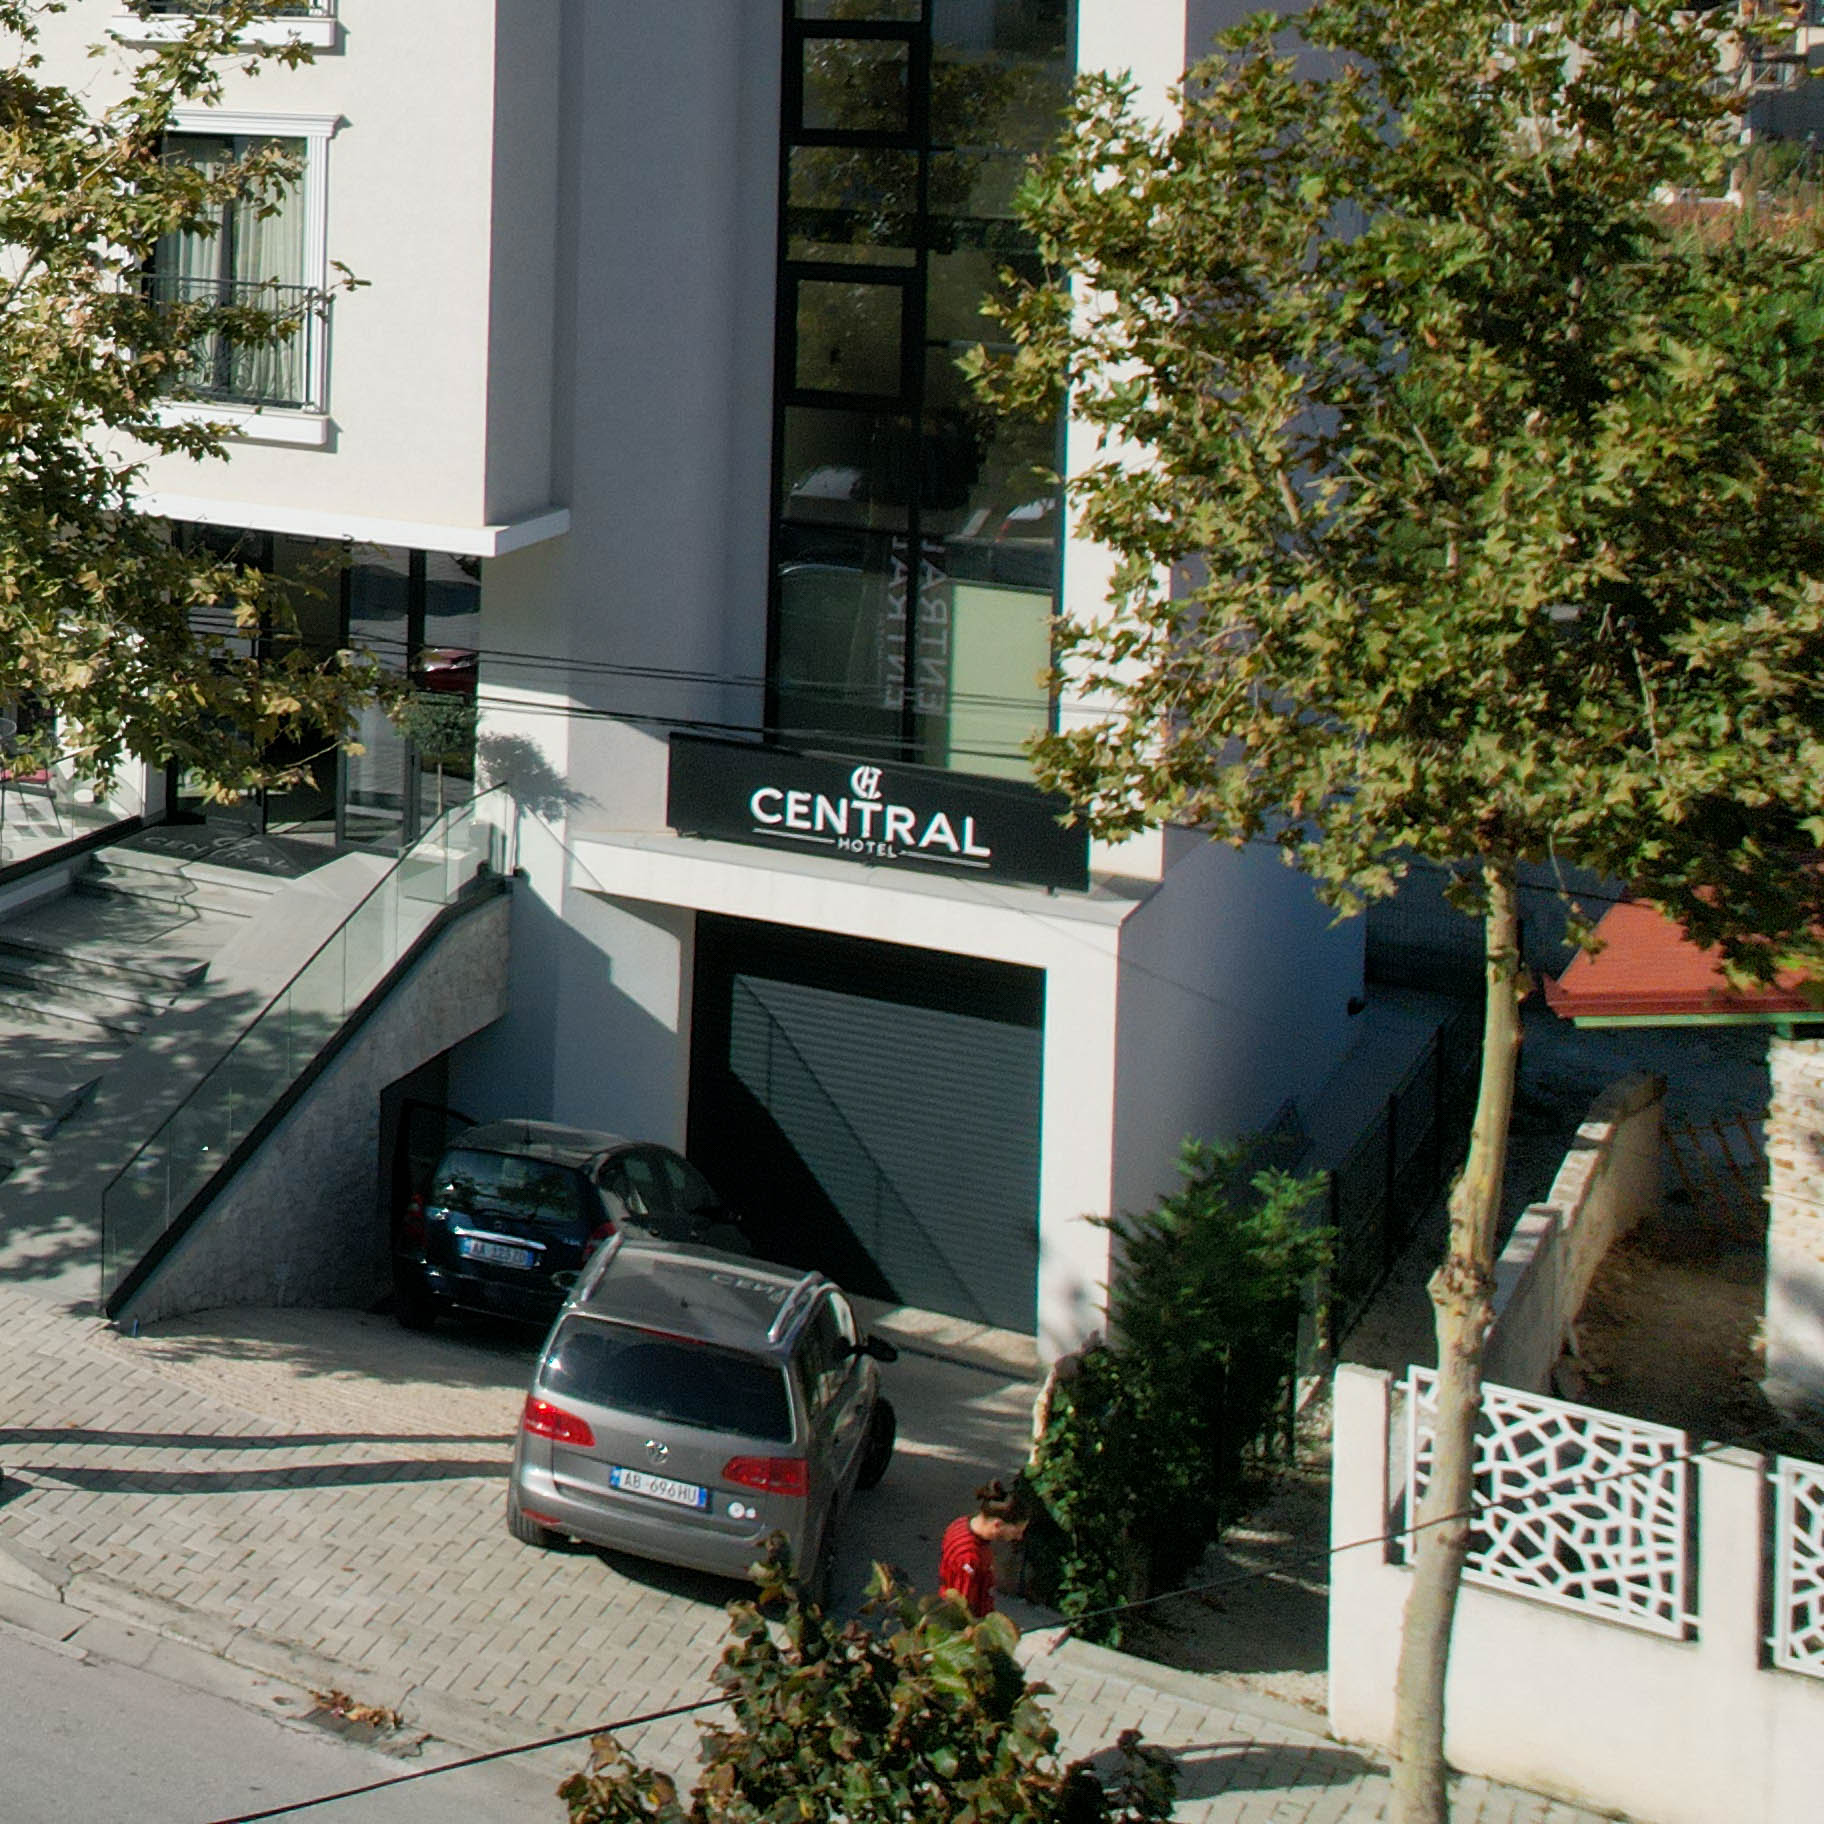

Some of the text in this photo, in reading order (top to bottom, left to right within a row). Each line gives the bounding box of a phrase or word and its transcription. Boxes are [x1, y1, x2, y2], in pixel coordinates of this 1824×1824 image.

[750, 787, 992, 858] CENTRAL
[837, 837, 898, 859] HOTEL
[624, 1472, 641, 1488] AB
